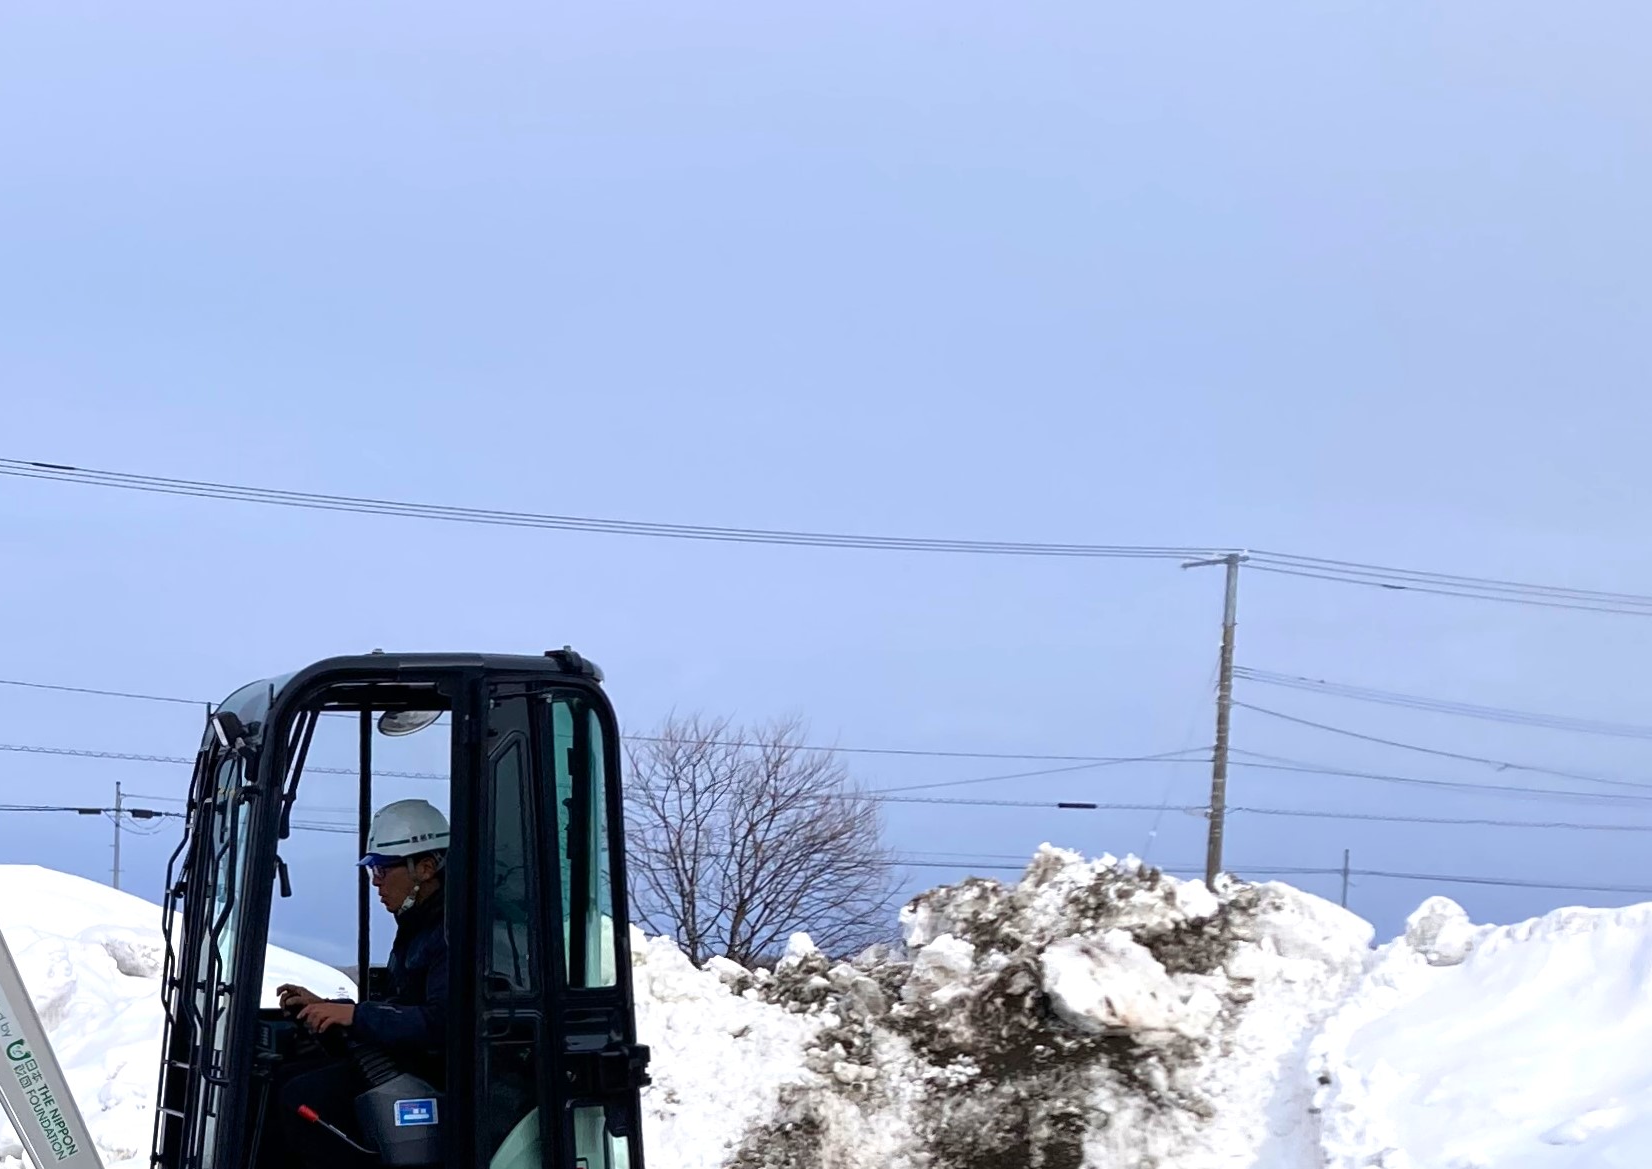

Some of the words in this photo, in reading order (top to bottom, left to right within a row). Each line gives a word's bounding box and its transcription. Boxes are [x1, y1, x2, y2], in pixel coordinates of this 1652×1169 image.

[1, 1022, 13, 1038] by
[25, 1059, 43, 1083] 日本
[26, 1089, 67, 1161] FOUNDATION
[38, 1083, 55, 1107] THE
[49, 1108, 78, 1156] NIPPON
